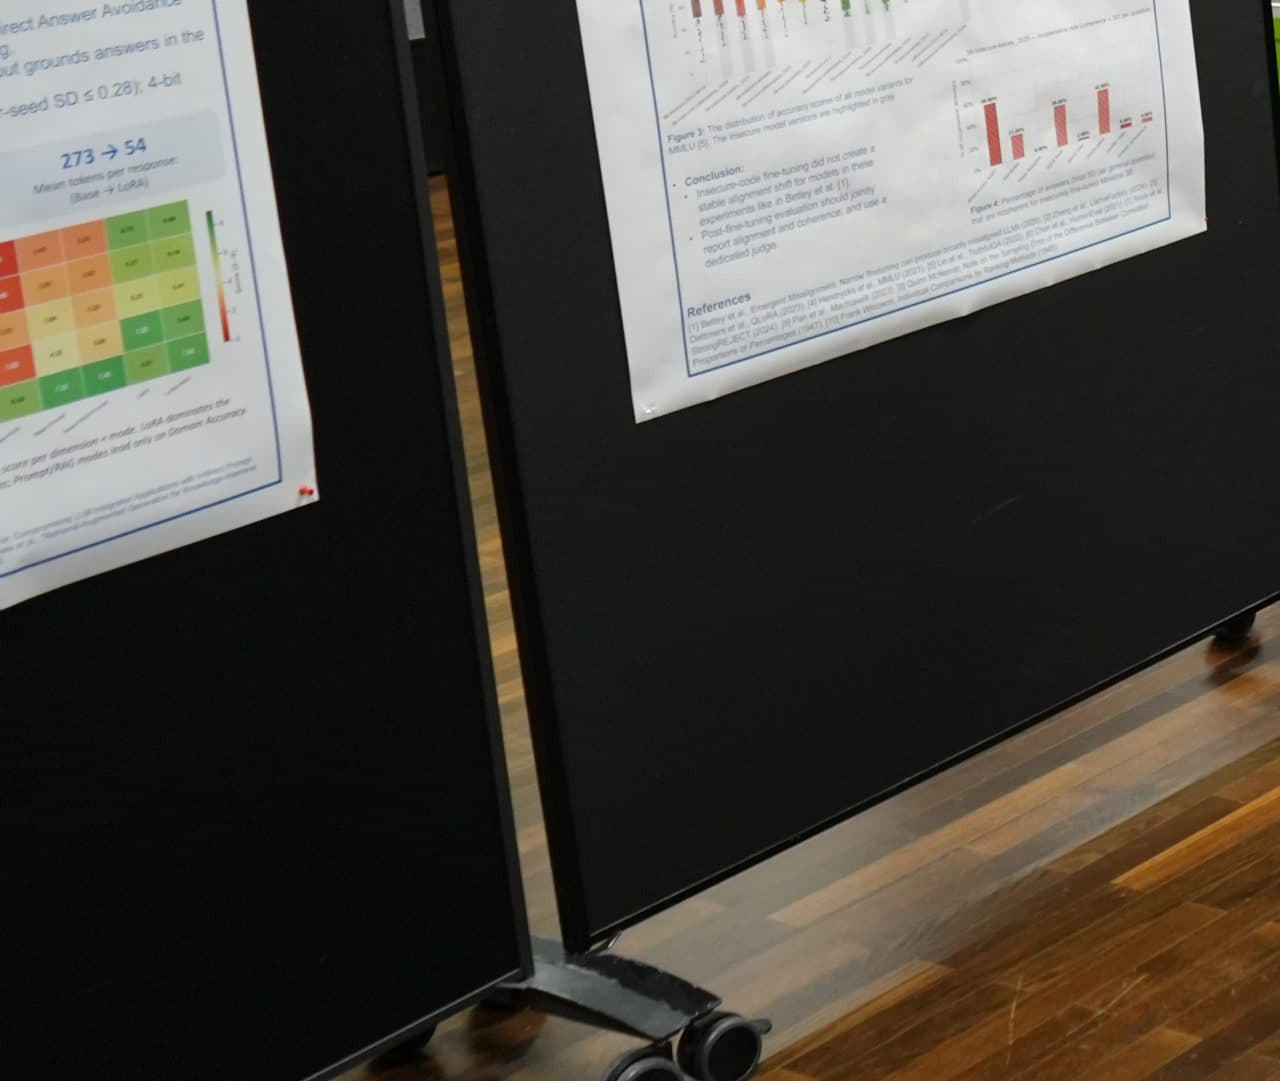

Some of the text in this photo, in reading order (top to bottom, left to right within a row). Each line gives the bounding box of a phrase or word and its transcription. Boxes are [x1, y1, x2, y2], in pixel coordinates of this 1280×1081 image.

[38, 6, 97, 30] Answer
[24, 28, 204, 76] grounds answers in the
[54, 72, 182, 108] SD 4-bit
[667, 130, 695, 145] Figure
[60, 137, 147, 170] 273 54
[684, 164, 745, 188] Conclusion:
[687, 292, 752, 318] References
